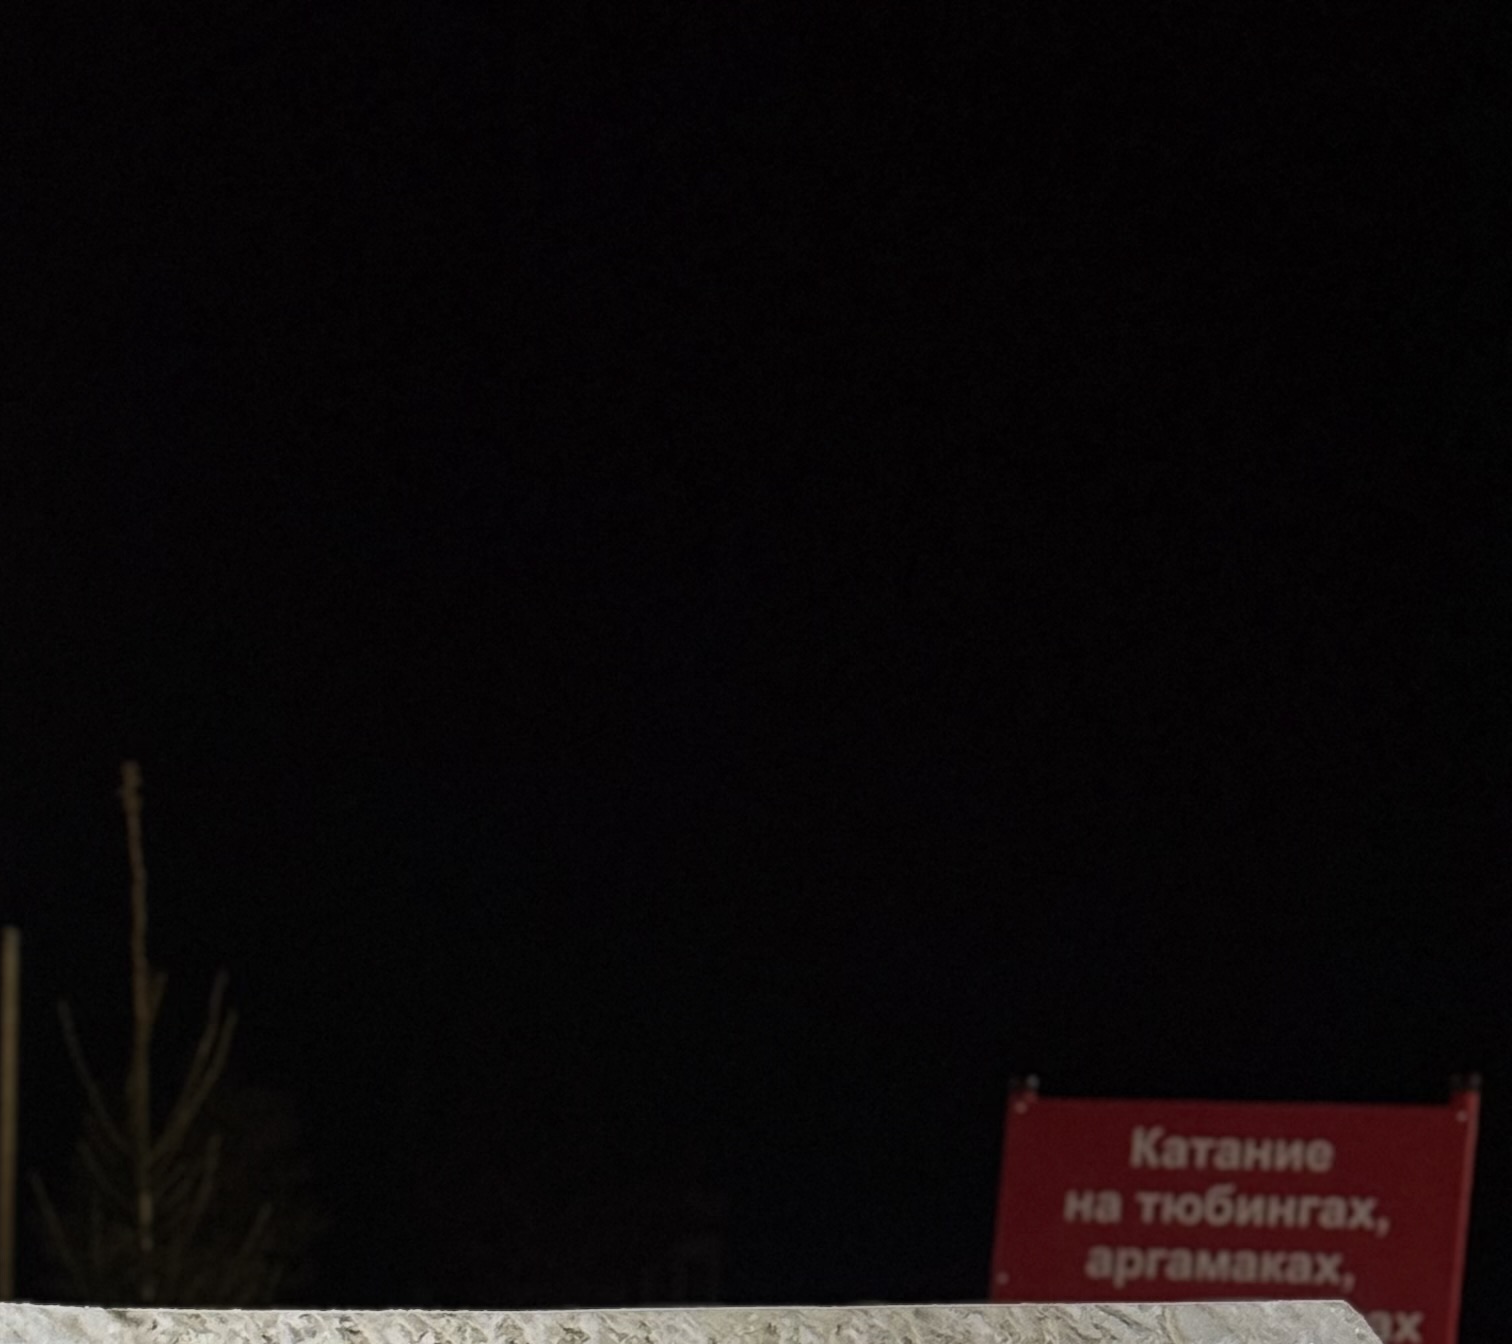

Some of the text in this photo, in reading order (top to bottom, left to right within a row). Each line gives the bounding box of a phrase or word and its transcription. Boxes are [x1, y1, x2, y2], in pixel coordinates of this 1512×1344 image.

[1129, 1126, 1334, 1172] Катание
[1064, 1184, 1390, 1236] на тюбингах,
[1085, 1244, 1356, 1290] аргамаках,
